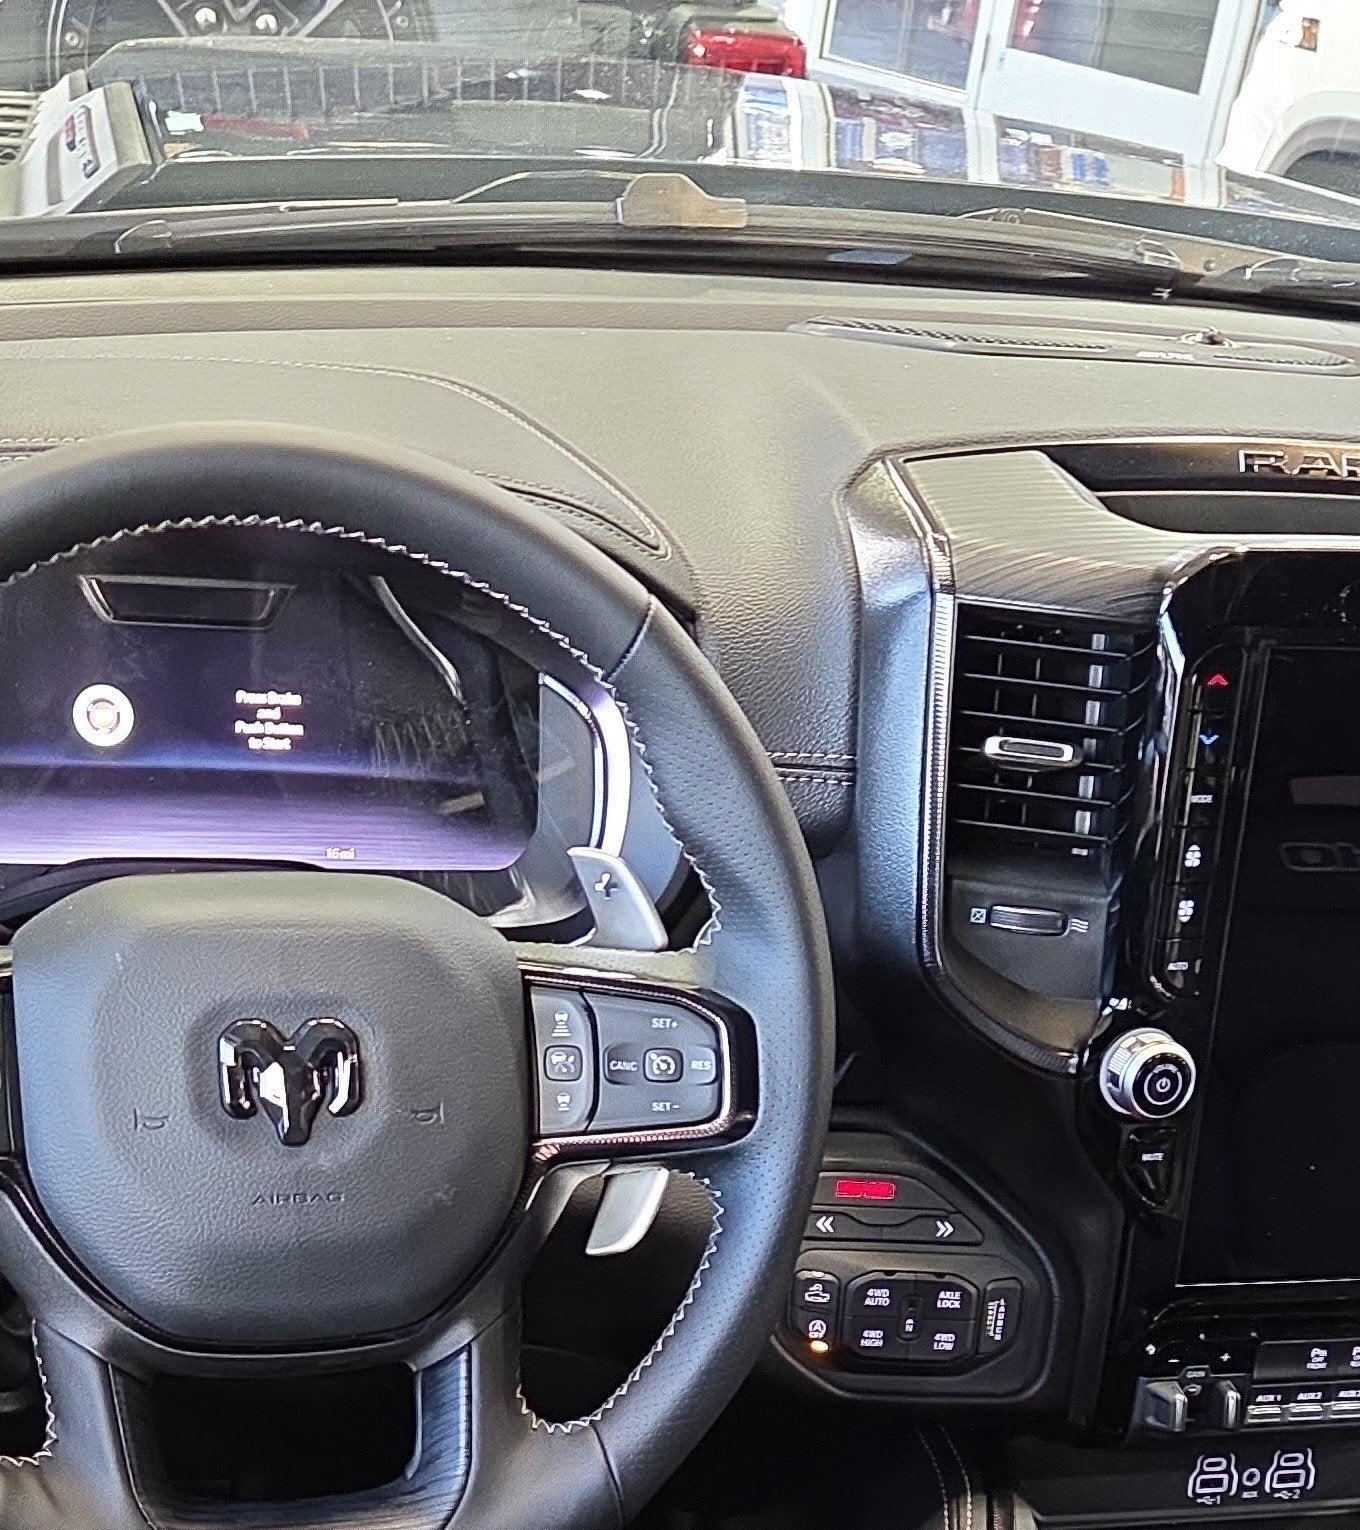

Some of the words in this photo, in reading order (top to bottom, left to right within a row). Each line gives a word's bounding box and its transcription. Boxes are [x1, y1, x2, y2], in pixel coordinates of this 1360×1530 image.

[609, 1060, 638, 1072] CANC
[691, 1060, 712, 1071] RES
[251, 1191, 345, 1206] AIRBAG
[866, 1288, 890, 1297] 4WD
[939, 1291, 961, 1300] AXLE
[863, 1297, 890, 1306] AUTO
[937, 1299, 961, 1309] LOCK
[862, 1329, 884, 1339] 4WD
[933, 1333, 956, 1342] 4WD
[860, 1338, 884, 1347] HIGH
[933, 1341, 954, 1351] LOW
